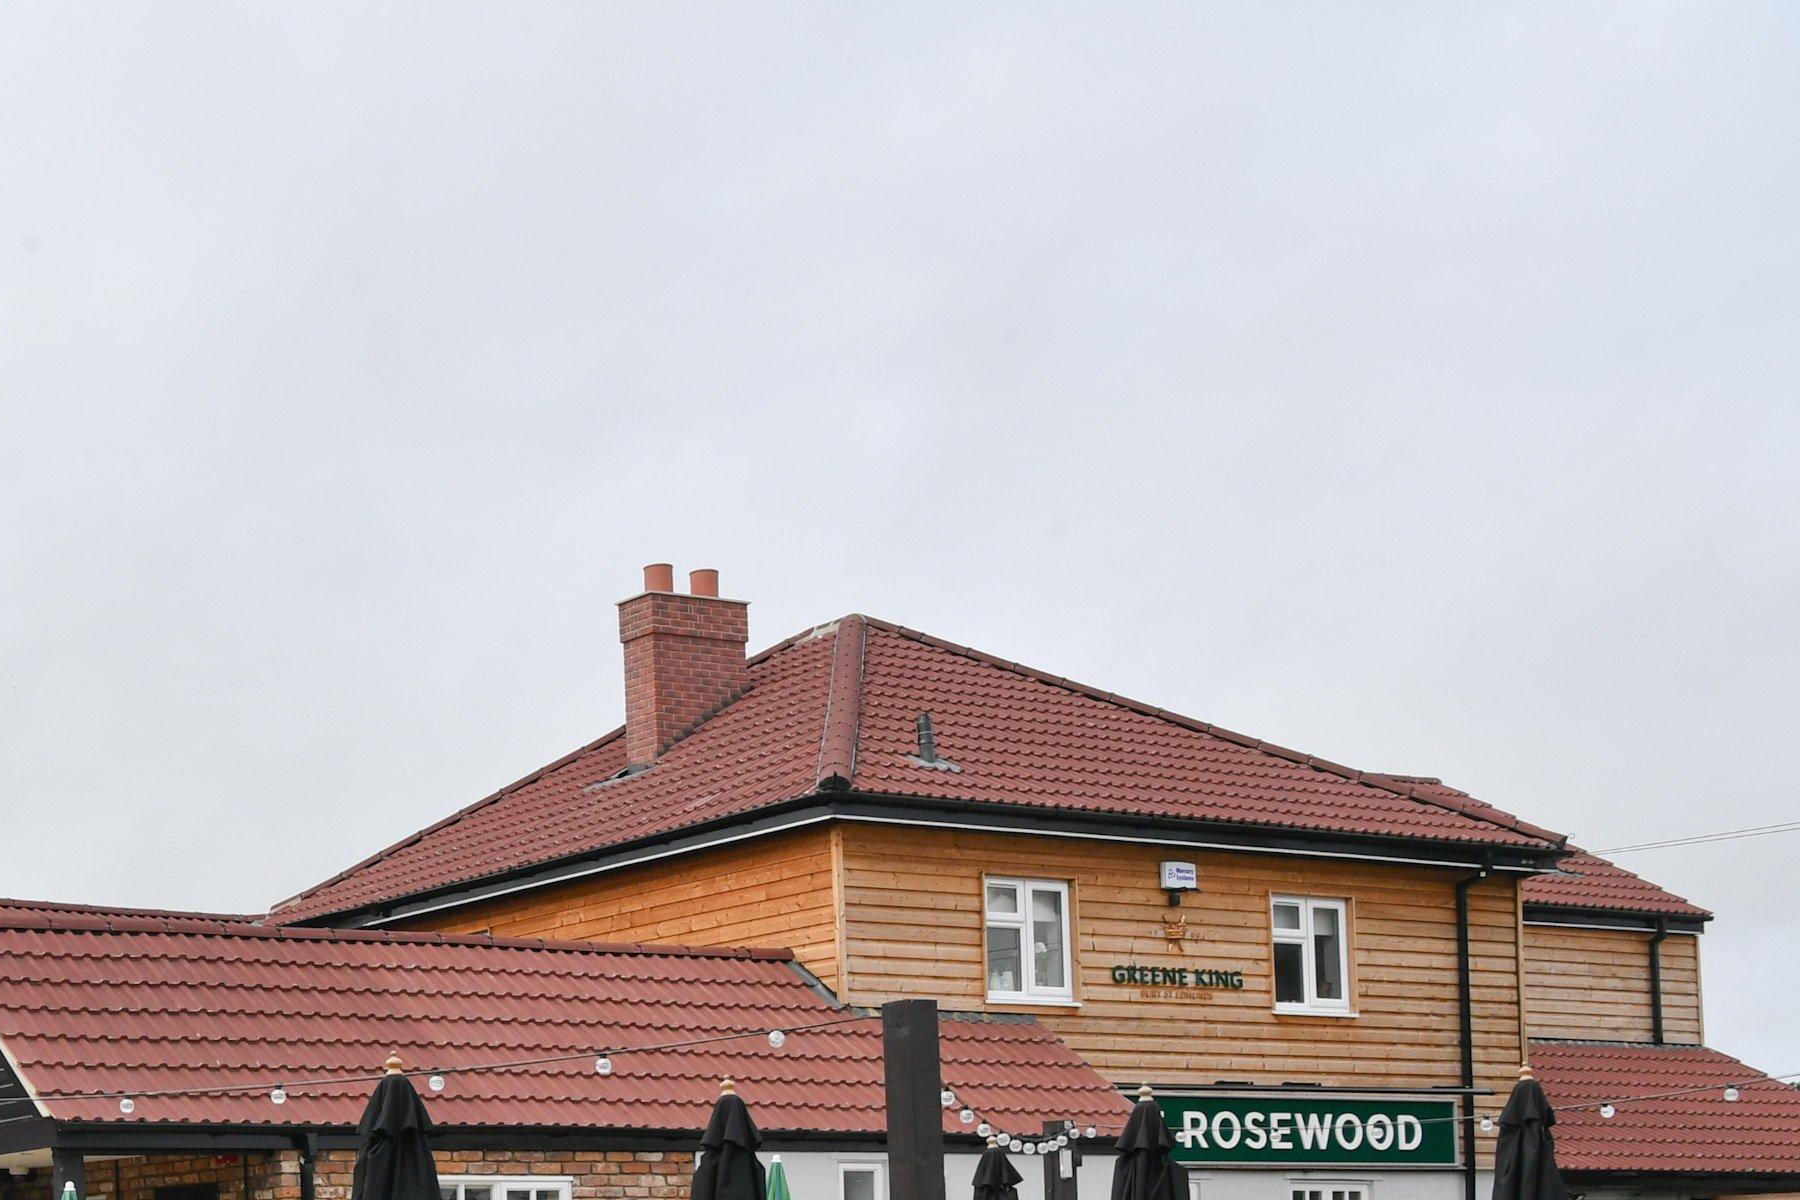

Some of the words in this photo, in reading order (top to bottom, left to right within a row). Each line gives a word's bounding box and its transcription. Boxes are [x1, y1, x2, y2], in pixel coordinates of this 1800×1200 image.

[1112, 964, 1188, 987] GREENE
[1194, 968, 1244, 989] KING
[1182, 1110, 1423, 1151] ROSEWOOD
